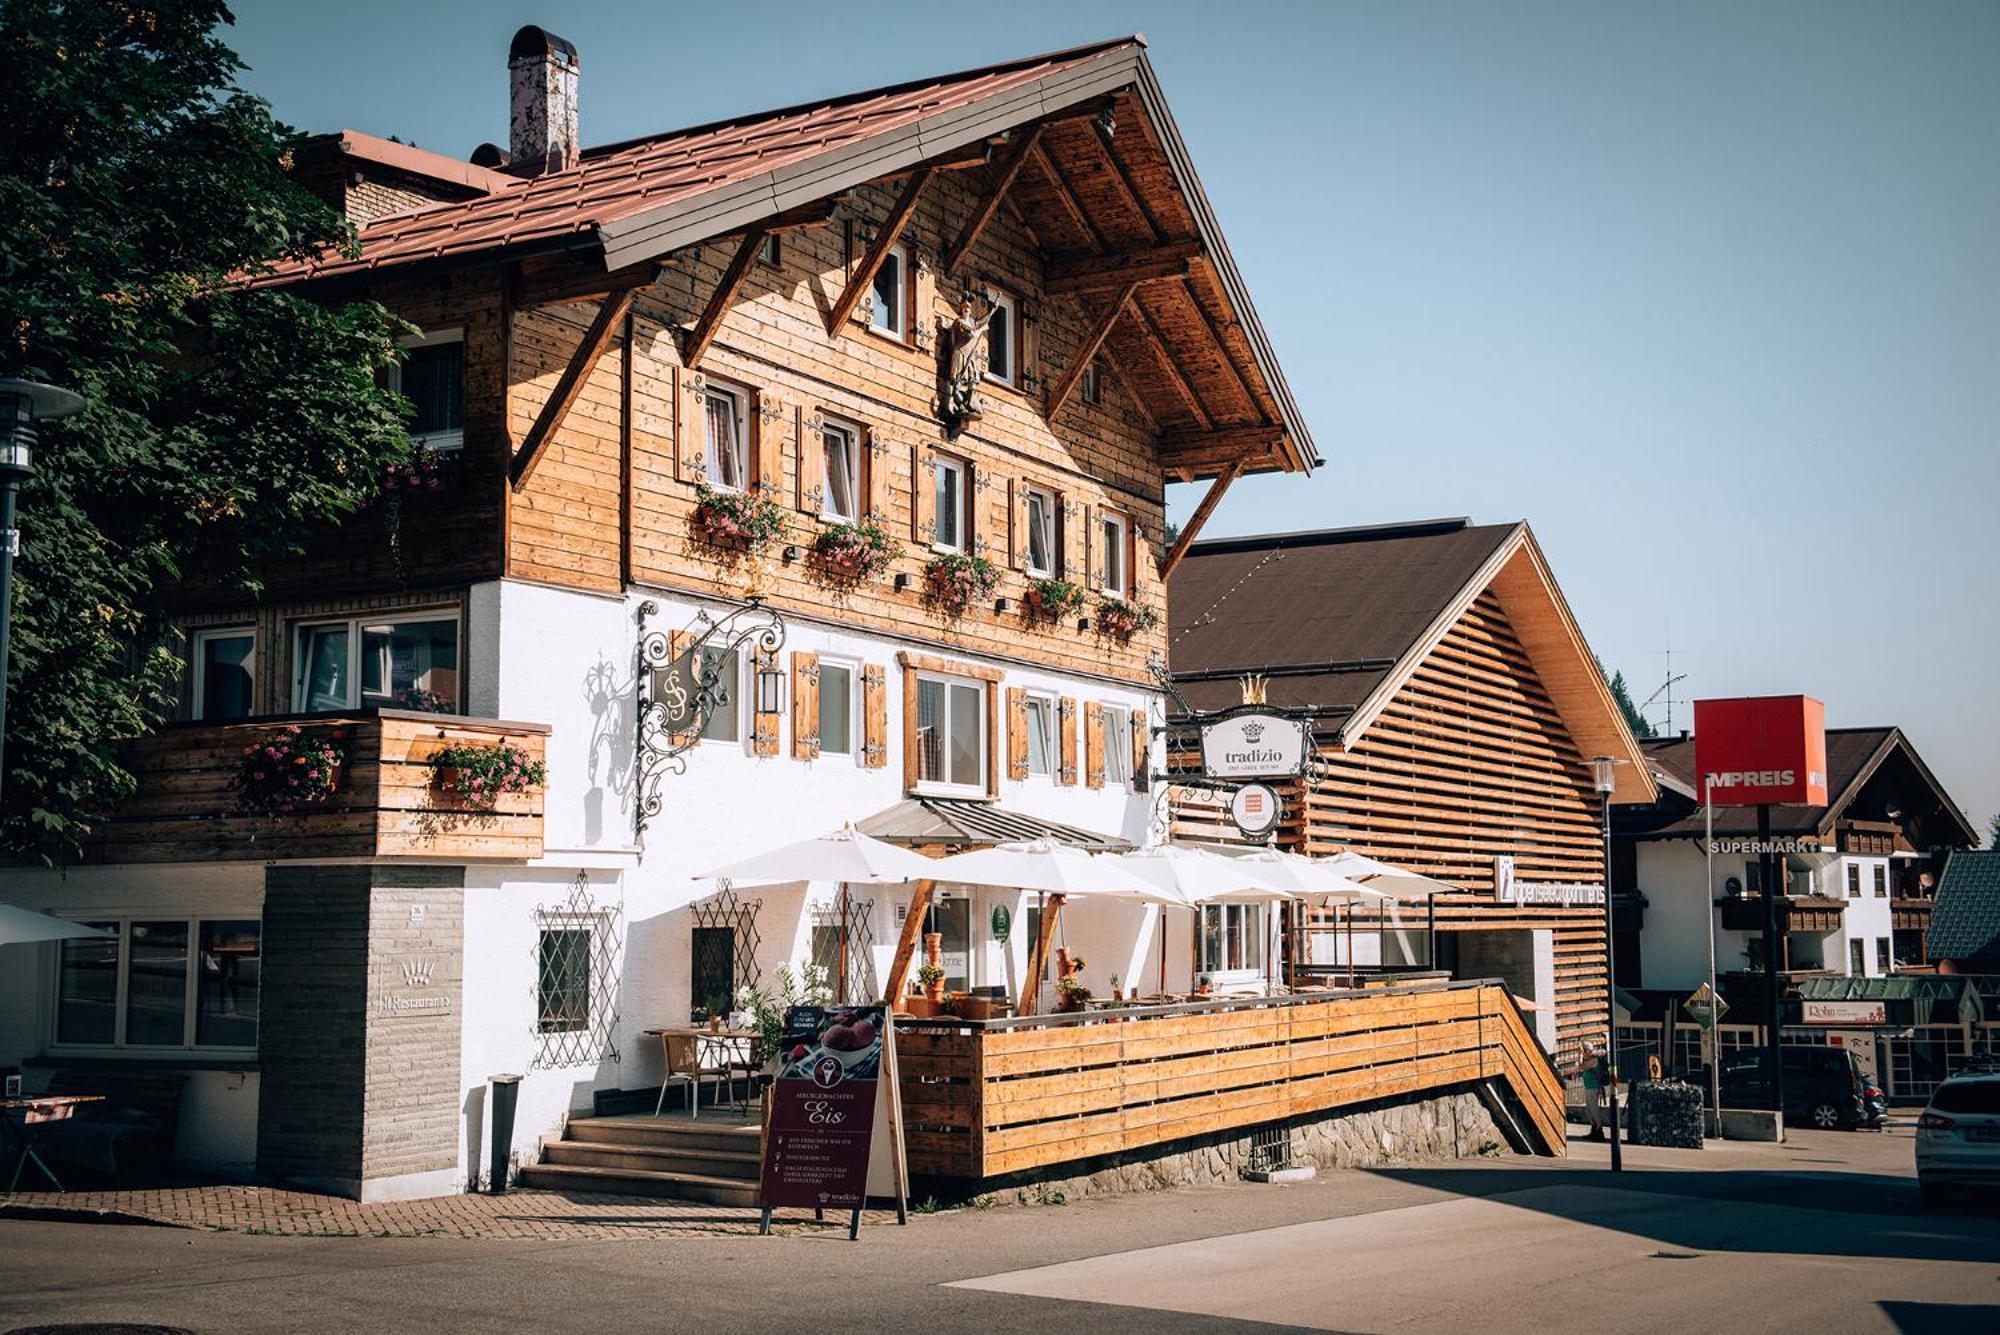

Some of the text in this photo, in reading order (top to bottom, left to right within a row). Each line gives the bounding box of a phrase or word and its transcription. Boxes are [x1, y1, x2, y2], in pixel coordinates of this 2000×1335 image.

[1226, 749, 1282, 763] tradizio
[1709, 770, 1795, 787] MPREIS
[1710, 842, 1818, 853] SUPERMARKT
[804, 1101, 846, 1124] Eis
